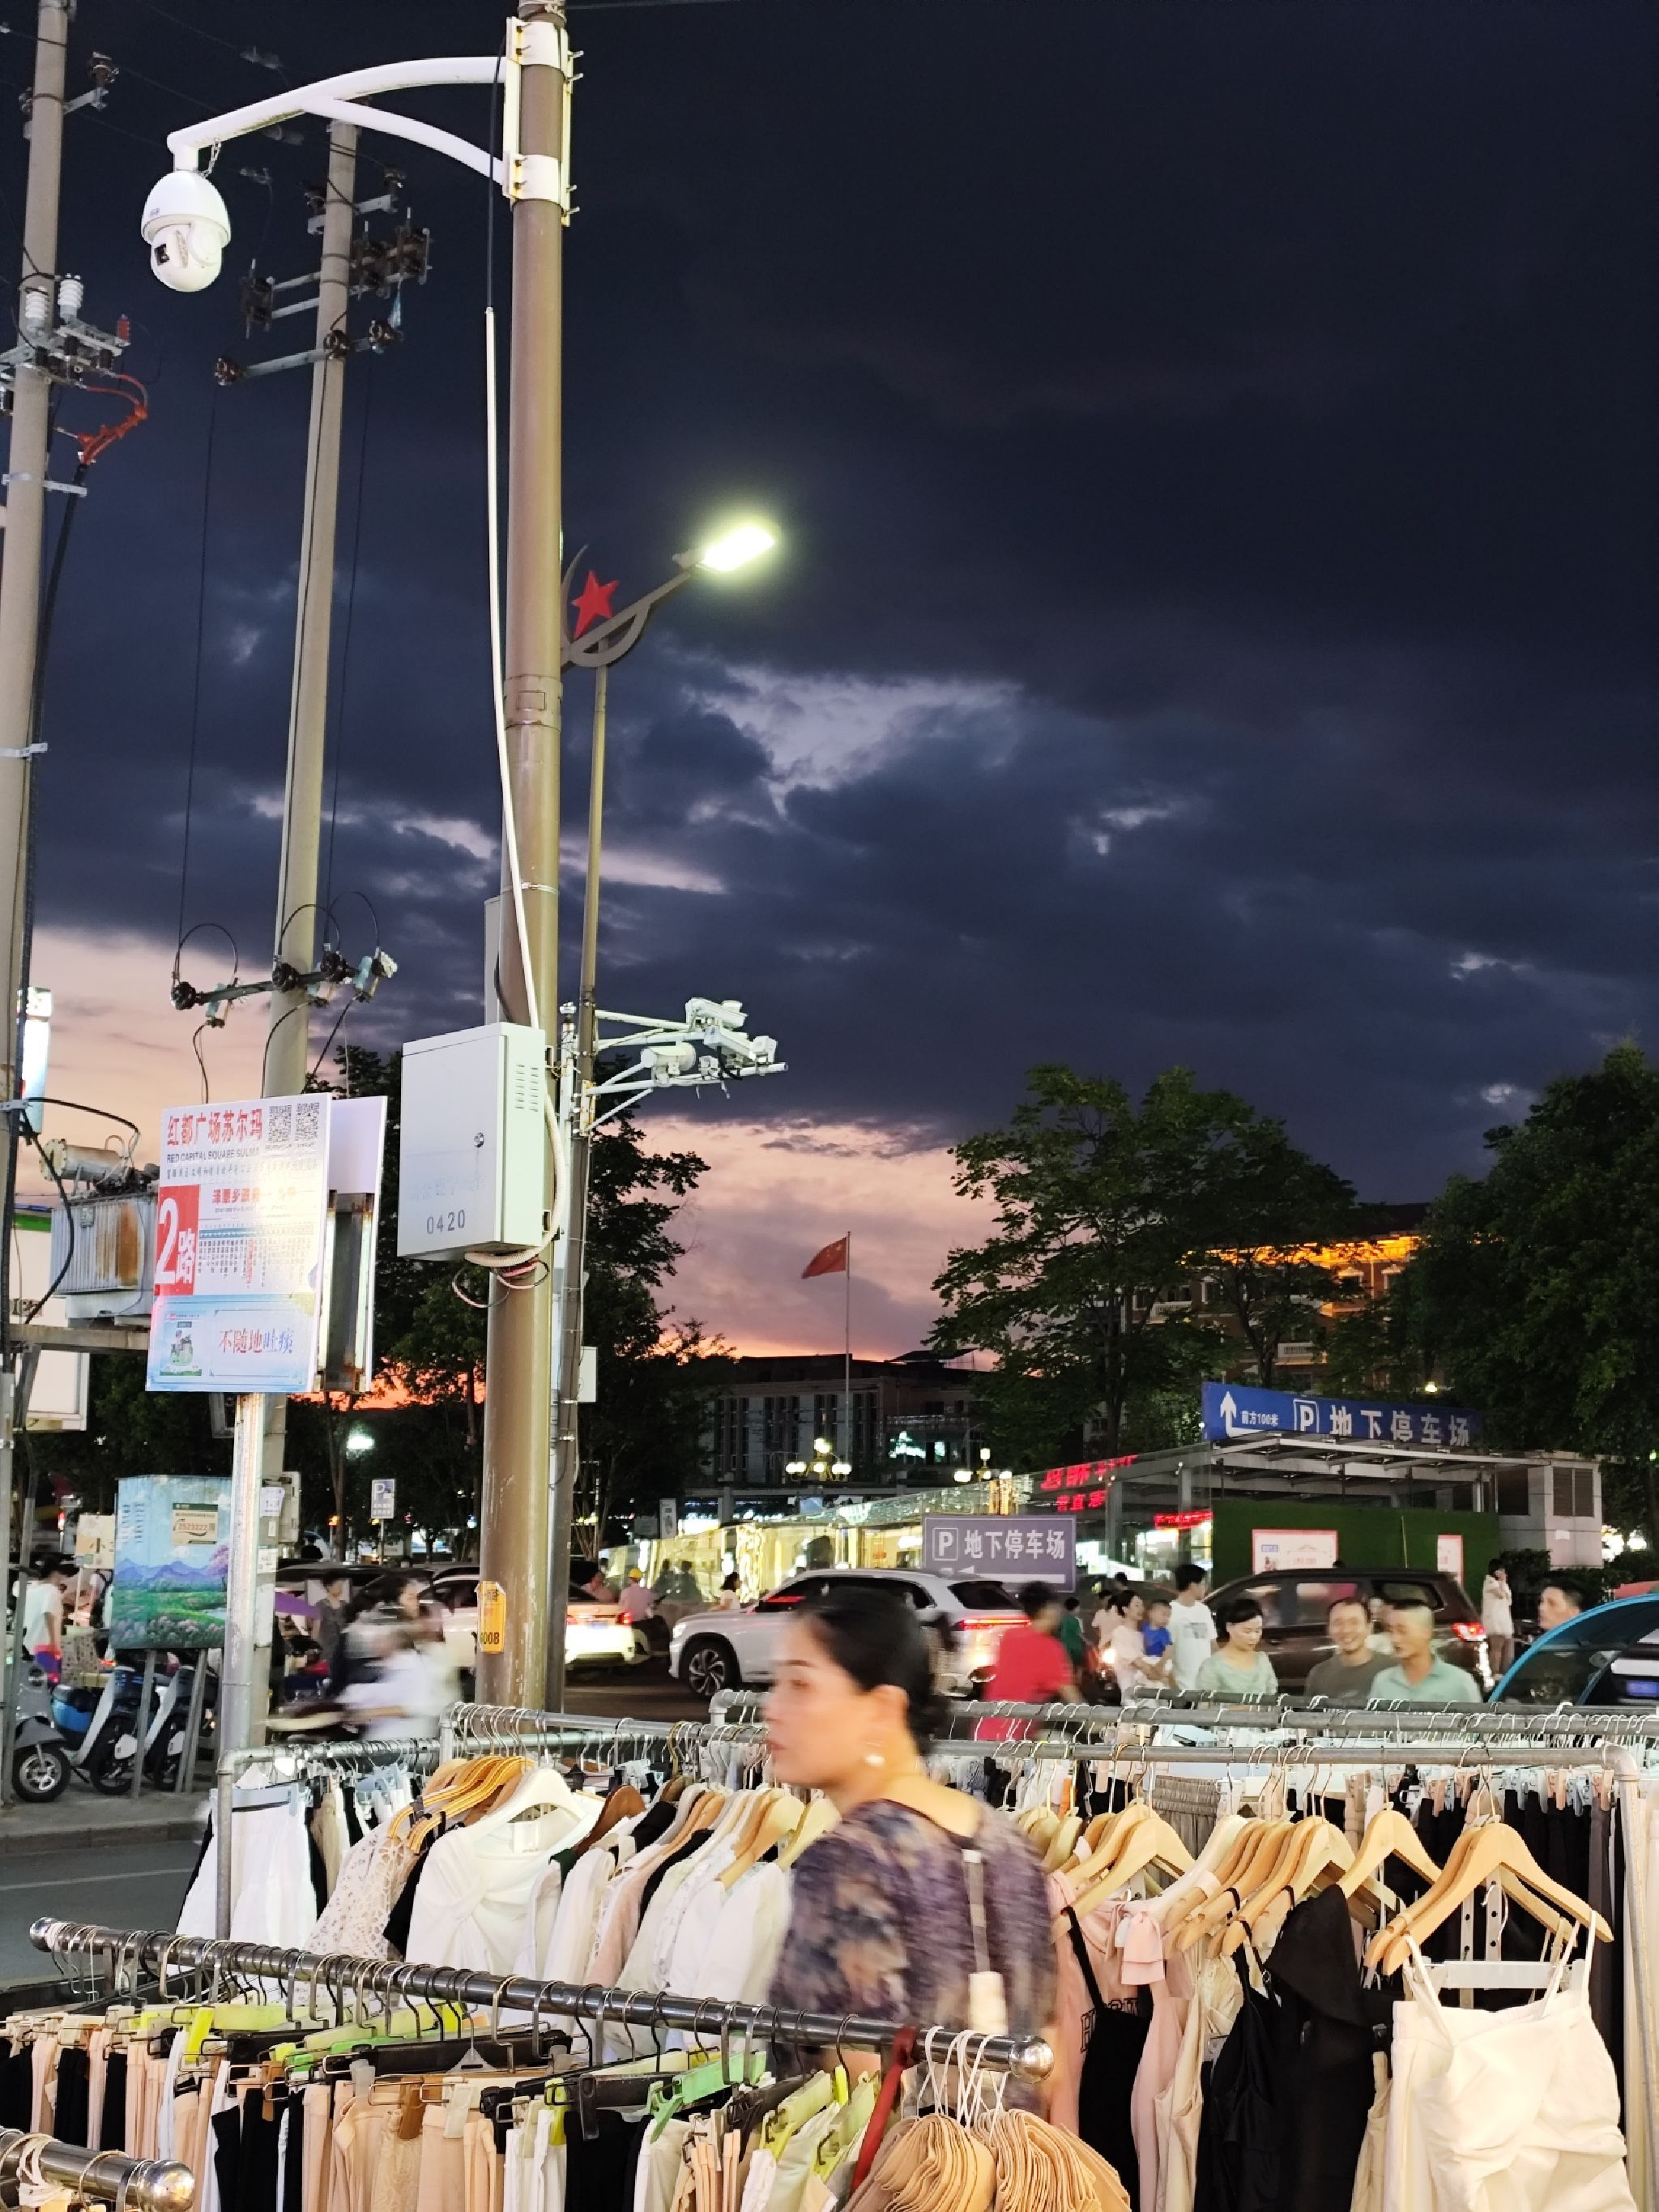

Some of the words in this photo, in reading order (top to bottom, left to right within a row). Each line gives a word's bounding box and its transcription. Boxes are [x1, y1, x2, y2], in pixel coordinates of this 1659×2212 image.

[167, 1108, 262, 1146] 红都广场苏尔玛
[167, 1153, 180, 1164] RED
[181, 1151, 207, 1162] CAPITAL
[426, 1209, 465, 1234] 0420
[219, 1327, 295, 1354] 不随地吐痰
[1241, 1411, 1278, 1427] 前方100米
[1300, 1404, 1314, 1432] P
[1329, 1404, 1470, 1447] 地下停车场
[938, 1531, 953, 1557] P
[964, 1529, 1065, 1560] 地下停车场
